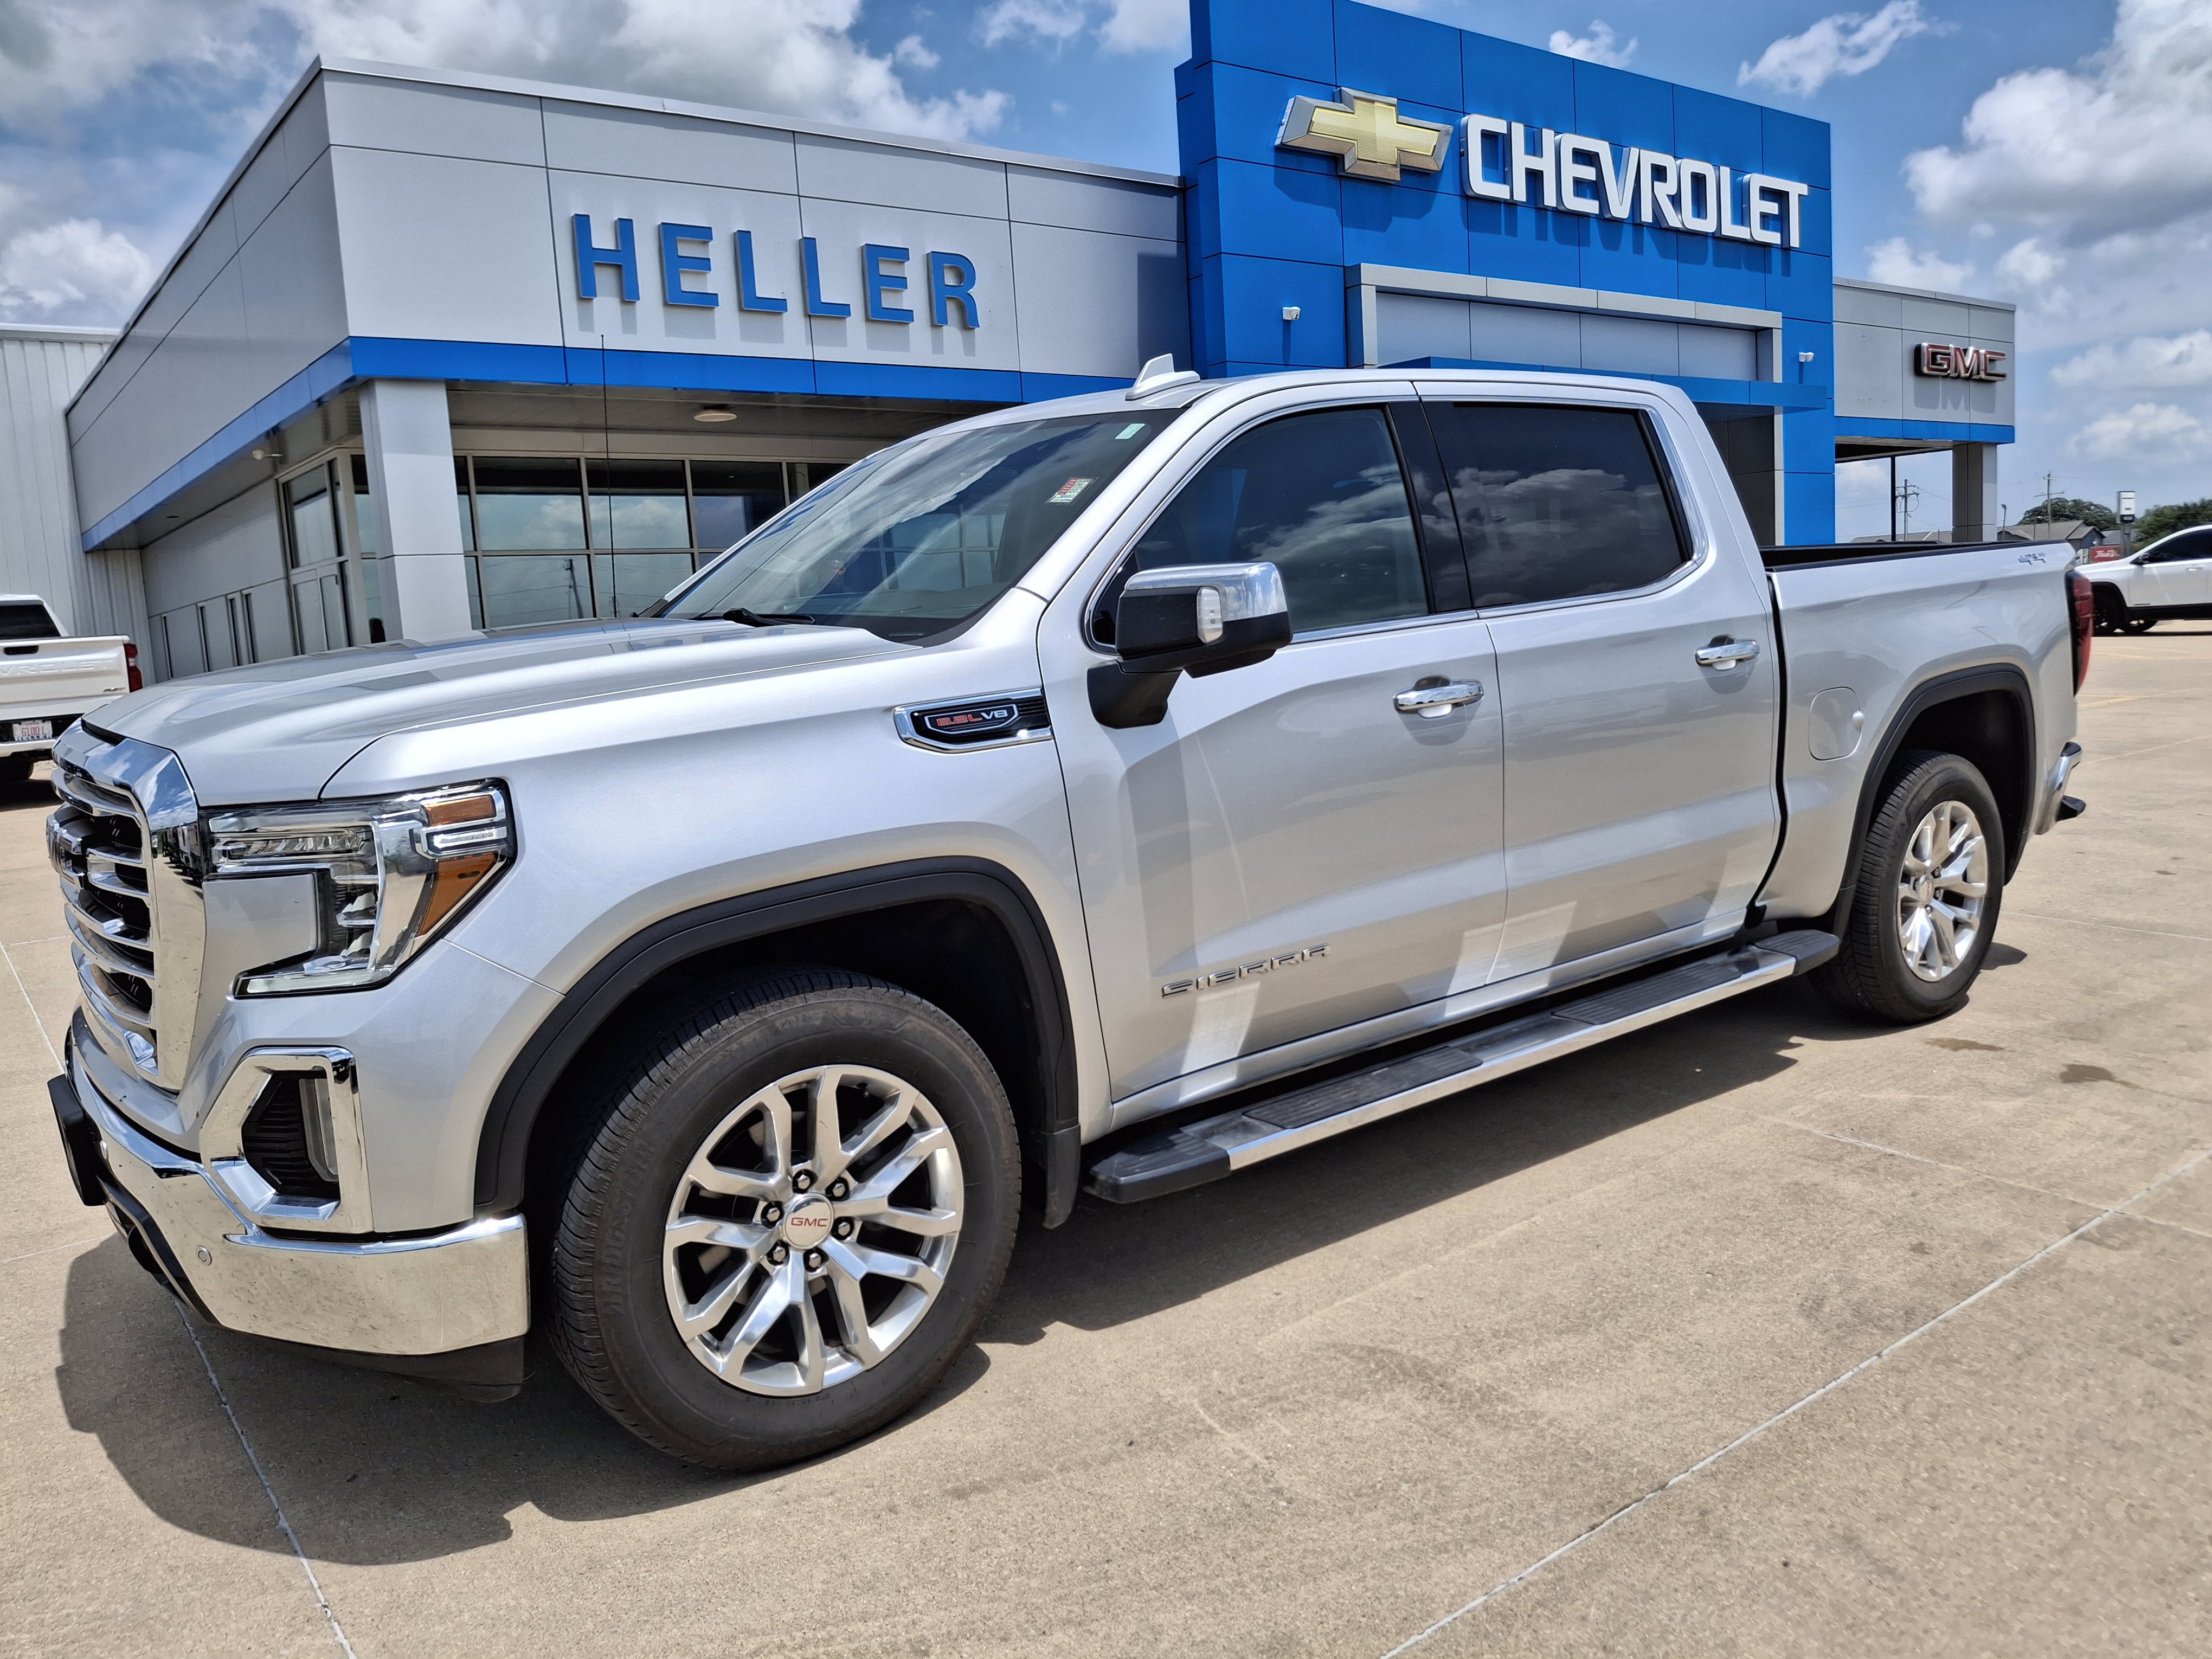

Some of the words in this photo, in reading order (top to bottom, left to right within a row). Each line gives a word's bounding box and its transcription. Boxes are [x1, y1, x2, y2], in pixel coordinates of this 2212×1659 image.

[1459, 113, 1808, 248] CHEVROLET
[571, 213, 980, 329] HELLER
[1916, 343, 2007, 382] GMC
[1162, 943, 1330, 998] SIERRA
[791, 1217, 828, 1227] GMC
